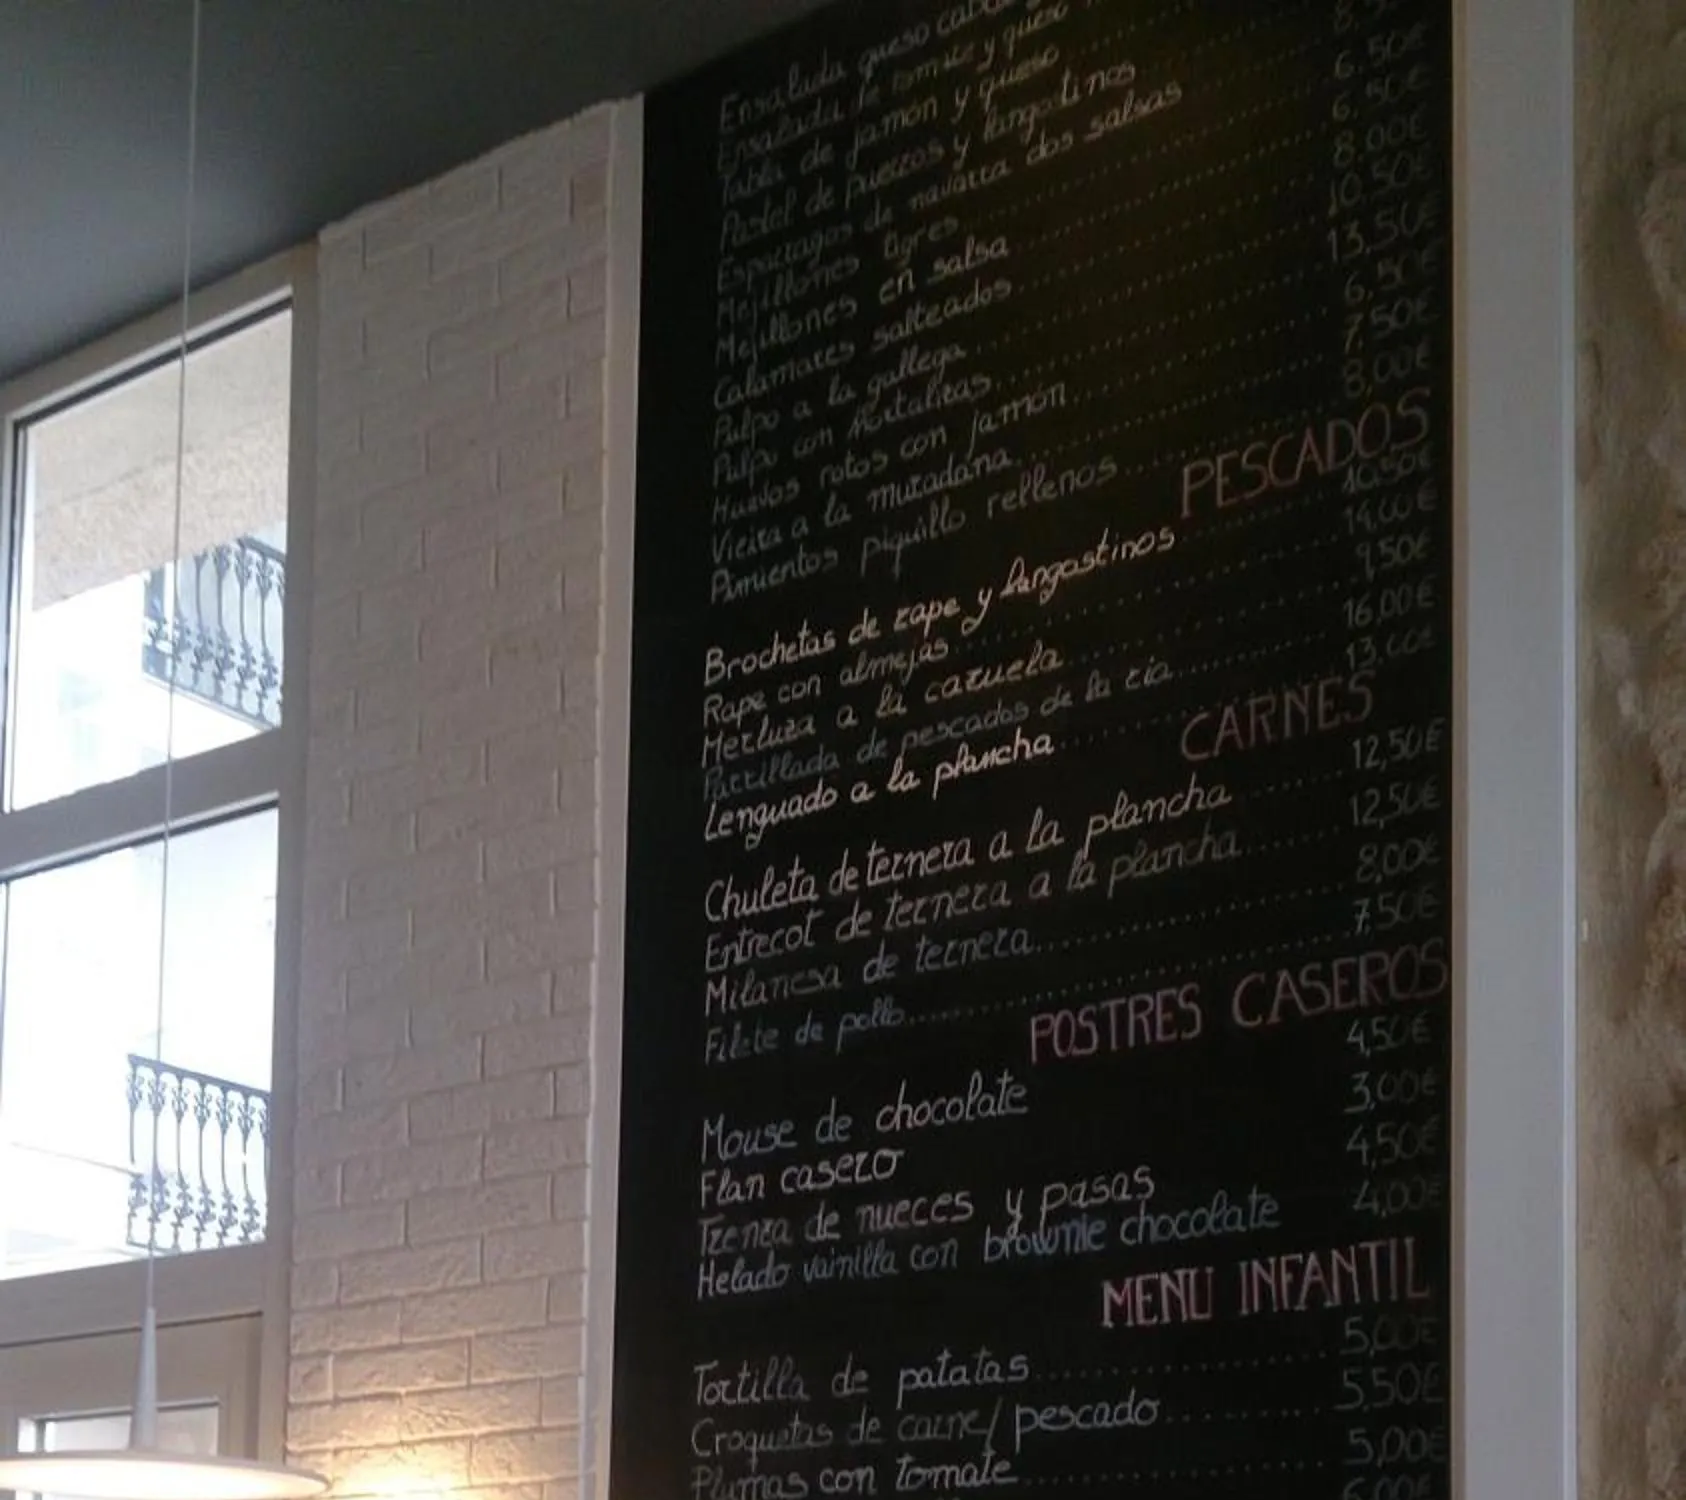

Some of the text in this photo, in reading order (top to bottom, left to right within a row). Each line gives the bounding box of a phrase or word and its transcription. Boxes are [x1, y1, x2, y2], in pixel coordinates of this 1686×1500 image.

[857, 22, 930, 82] queso
[966, 36, 996, 73] y
[1003, 3, 1068, 60] queso
[800, 136, 835, 175] de
[950, 85, 970, 124] y
[804, 177, 836, 217] de
[952, 133, 970, 172] y
[863, 198, 893, 233] de
[1026, 128, 1074, 167] dos
[1083, 79, 1183, 144] salsas
[879, 268, 916, 305] en
[927, 235, 1010, 285] salsa
[714, 342, 856, 410] Calamares
[871, 278, 1012, 353] salteados
[714, 407, 781, 452] Pulpo
[793, 400, 812, 420] a
[828, 372, 856, 406] la
[867, 343, 967, 403] gallega
[713, 448, 778, 490] Pulpo
[793, 426, 833, 459] con
[713, 476, 800, 528] Huevos
[819, 450, 888, 490] rotos
[900, 425, 947, 461] con
[1180, 386, 1429, 519] PESCADOS
[710, 543, 838, 606] Pimientos
[860, 495, 966, 583] piquillo
[987, 454, 1117, 521] rellenos
[791, 516, 809, 539] a
[825, 491, 852, 528] la
[703, 617, 835, 688] Brochetas
[848, 605, 881, 645] de
[962, 586, 993, 636] y
[703, 689, 767, 730] Rape
[777, 672, 821, 704] con
[838, 637, 950, 686] almejas
[701, 714, 816, 770] Merluza
[836, 703, 858, 730] a
[875, 683, 907, 720] la
[924, 639, 1064, 704] cazuela
[703, 742, 840, 803] Parrillada
[855, 725, 889, 765] de
[899, 698, 1030, 760] pescados
[1039, 684, 1073, 716] de
[1085, 668, 1112, 703] la
[1180, 668, 1378, 762] CARNES
[703, 776, 838, 852] Lenguado
[850, 780, 876, 803] a
[887, 756, 920, 793] la
[931, 725, 1055, 801] plancha
[704, 852, 820, 922] Chuleta
[828, 847, 859, 898] de
[866, 839, 975, 886] ternera
[988, 828, 1013, 862] a
[1025, 805, 1065, 854] la
[1083, 772, 1233, 862] plancha
[704, 908, 824, 973] Entrecot
[835, 895, 873, 942] de
[882, 888, 1012, 932] ternera
[1028, 870, 1052, 900] a
[1066, 846, 1099, 893] la
[1106, 812, 1243, 900] plancha
[704, 964, 844, 1018] Milanesa
[862, 937, 900, 984] de
[914, 926, 1034, 975] ternera
[1030, 937, 1449, 1065] POSTRES CASEROS
[704, 1018, 780, 1067] Filete
[794, 1008, 824, 1046] de
[834, 993, 906, 1057] pollo
[700, 1112, 799, 1166] Mouse
[815, 1095, 853, 1144] de
[875, 1068, 1030, 1132] chocolate
[698, 1212, 794, 1258] Trenza
[803, 1200, 841, 1243] de
[855, 1190, 976, 1233] nueces
[1005, 1186, 1024, 1243] y
[1040, 1164, 1156, 1245] pasas
[700, 1168, 766, 1211] Flan
[779, 1147, 906, 1194] casero
[697, 1250, 793, 1301] Helado
[803, 1237, 900, 1284] vainilla
[909, 1227, 960, 1272] con
[983, 1214, 1108, 1264] brownie
[1119, 1183, 1283, 1247] chocolate
[1101, 1235, 1431, 1330] MENU INFANTIL
[693, 1354, 811, 1406] Tortilla
[831, 1351, 870, 1397] de
[896, 1345, 1030, 1410] patatas
[690, 1410, 834, 1472] Croquetas
[847, 1402, 886, 1445] de
[818, 1465, 878, 1496] con
[895, 1448, 1020, 1492] tomate
